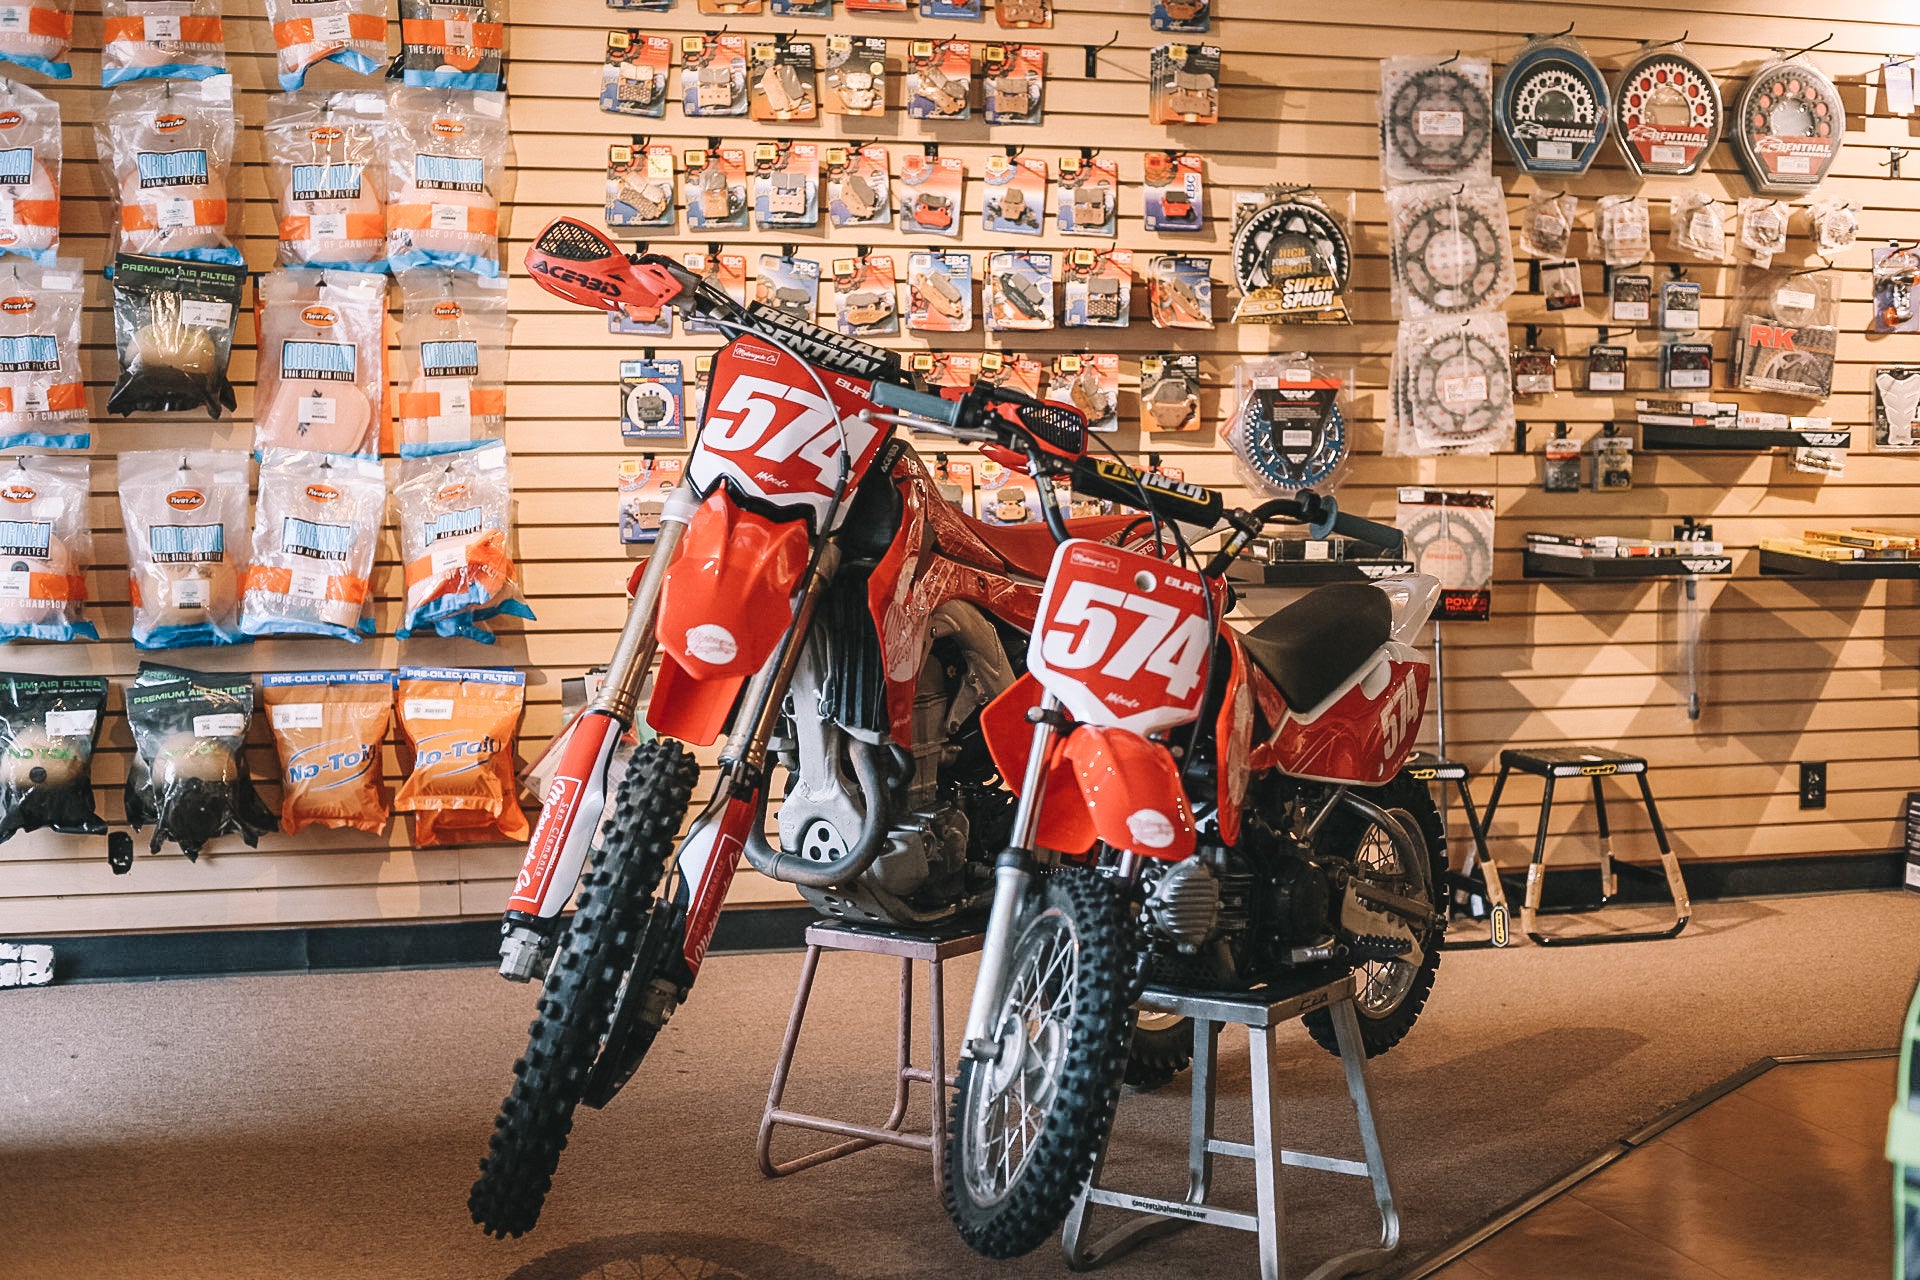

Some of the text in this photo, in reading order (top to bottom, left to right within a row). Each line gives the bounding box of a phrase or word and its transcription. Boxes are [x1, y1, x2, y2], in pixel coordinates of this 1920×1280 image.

[648, 38, 669, 48] EBC
[721, 36, 742, 46] EBC
[866, 38, 886, 48] EBC
[408, 44, 425, 54] THE
[790, 44, 811, 54] EBC
[950, 43, 969, 52] EBC
[1201, 46, 1221, 55] EBC
[1021, 49, 1041, 59] EBC
[1538, 127, 1596, 138] RENTHAL
[1652, 132, 1708, 142] RENTHAL
[794, 145, 815, 155] EBC
[1777, 142, 1833, 153] RENTHAL
[723, 150, 743, 160] EBC
[139, 151, 206, 178] ORIGINAL
[417, 154, 483, 183] ORIGINAL
[941, 159, 961, 168] EBC
[3, 175, 29, 184] FILTER
[164, 177, 177, 186] AIR
[179, 175, 208, 186] FILTER
[418, 181, 482, 192] FOAM AIR FILTER
[295, 191, 315, 199] FOAM
[333, 190, 360, 199] FILTER
[722, 255, 743, 265] EBC
[871, 257, 891, 267] EBC
[945, 256, 968, 266] EBC
[121, 263, 236, 282] PREMIUM AIR FILTER
[532, 260, 622, 297] ACERBIS
[1283, 276, 1334, 294] SUPER
[1282, 290, 1335, 309] SPROX
[754, 306, 888, 362] RENTHAL
[1749, 323, 1798, 351] RK
[756, 320, 881, 374] ENTHA
[284, 342, 353, 371] ORIGINAL
[423, 341, 478, 366] ORIGINAL
[17, 361, 58, 370] AIR FILTER
[658, 364, 679, 374] EBC
[1020, 361, 1038, 371] EBC
[702, 374, 880, 498] 574
[659, 461, 679, 470] EBC
[0, 522, 50, 548] IGINAL
[151, 525, 223, 553] ORIGINAL
[19, 547, 47, 556] FILTER
[1041, 579, 1211, 700] 574
[270, 675, 328, 684] PRE-OILED
[350, 674, 384, 682] FILTER
[407, 670, 517, 682] PRE-OILED AIR FILTER
[40, 679, 102, 688] AIR FILTER
[133, 690, 185, 705] PREMIUM
[1380, 668, 1420, 760] 574
[525, 780, 566, 868] Motorcycle
[535, 803, 570, 877] San Clemente
